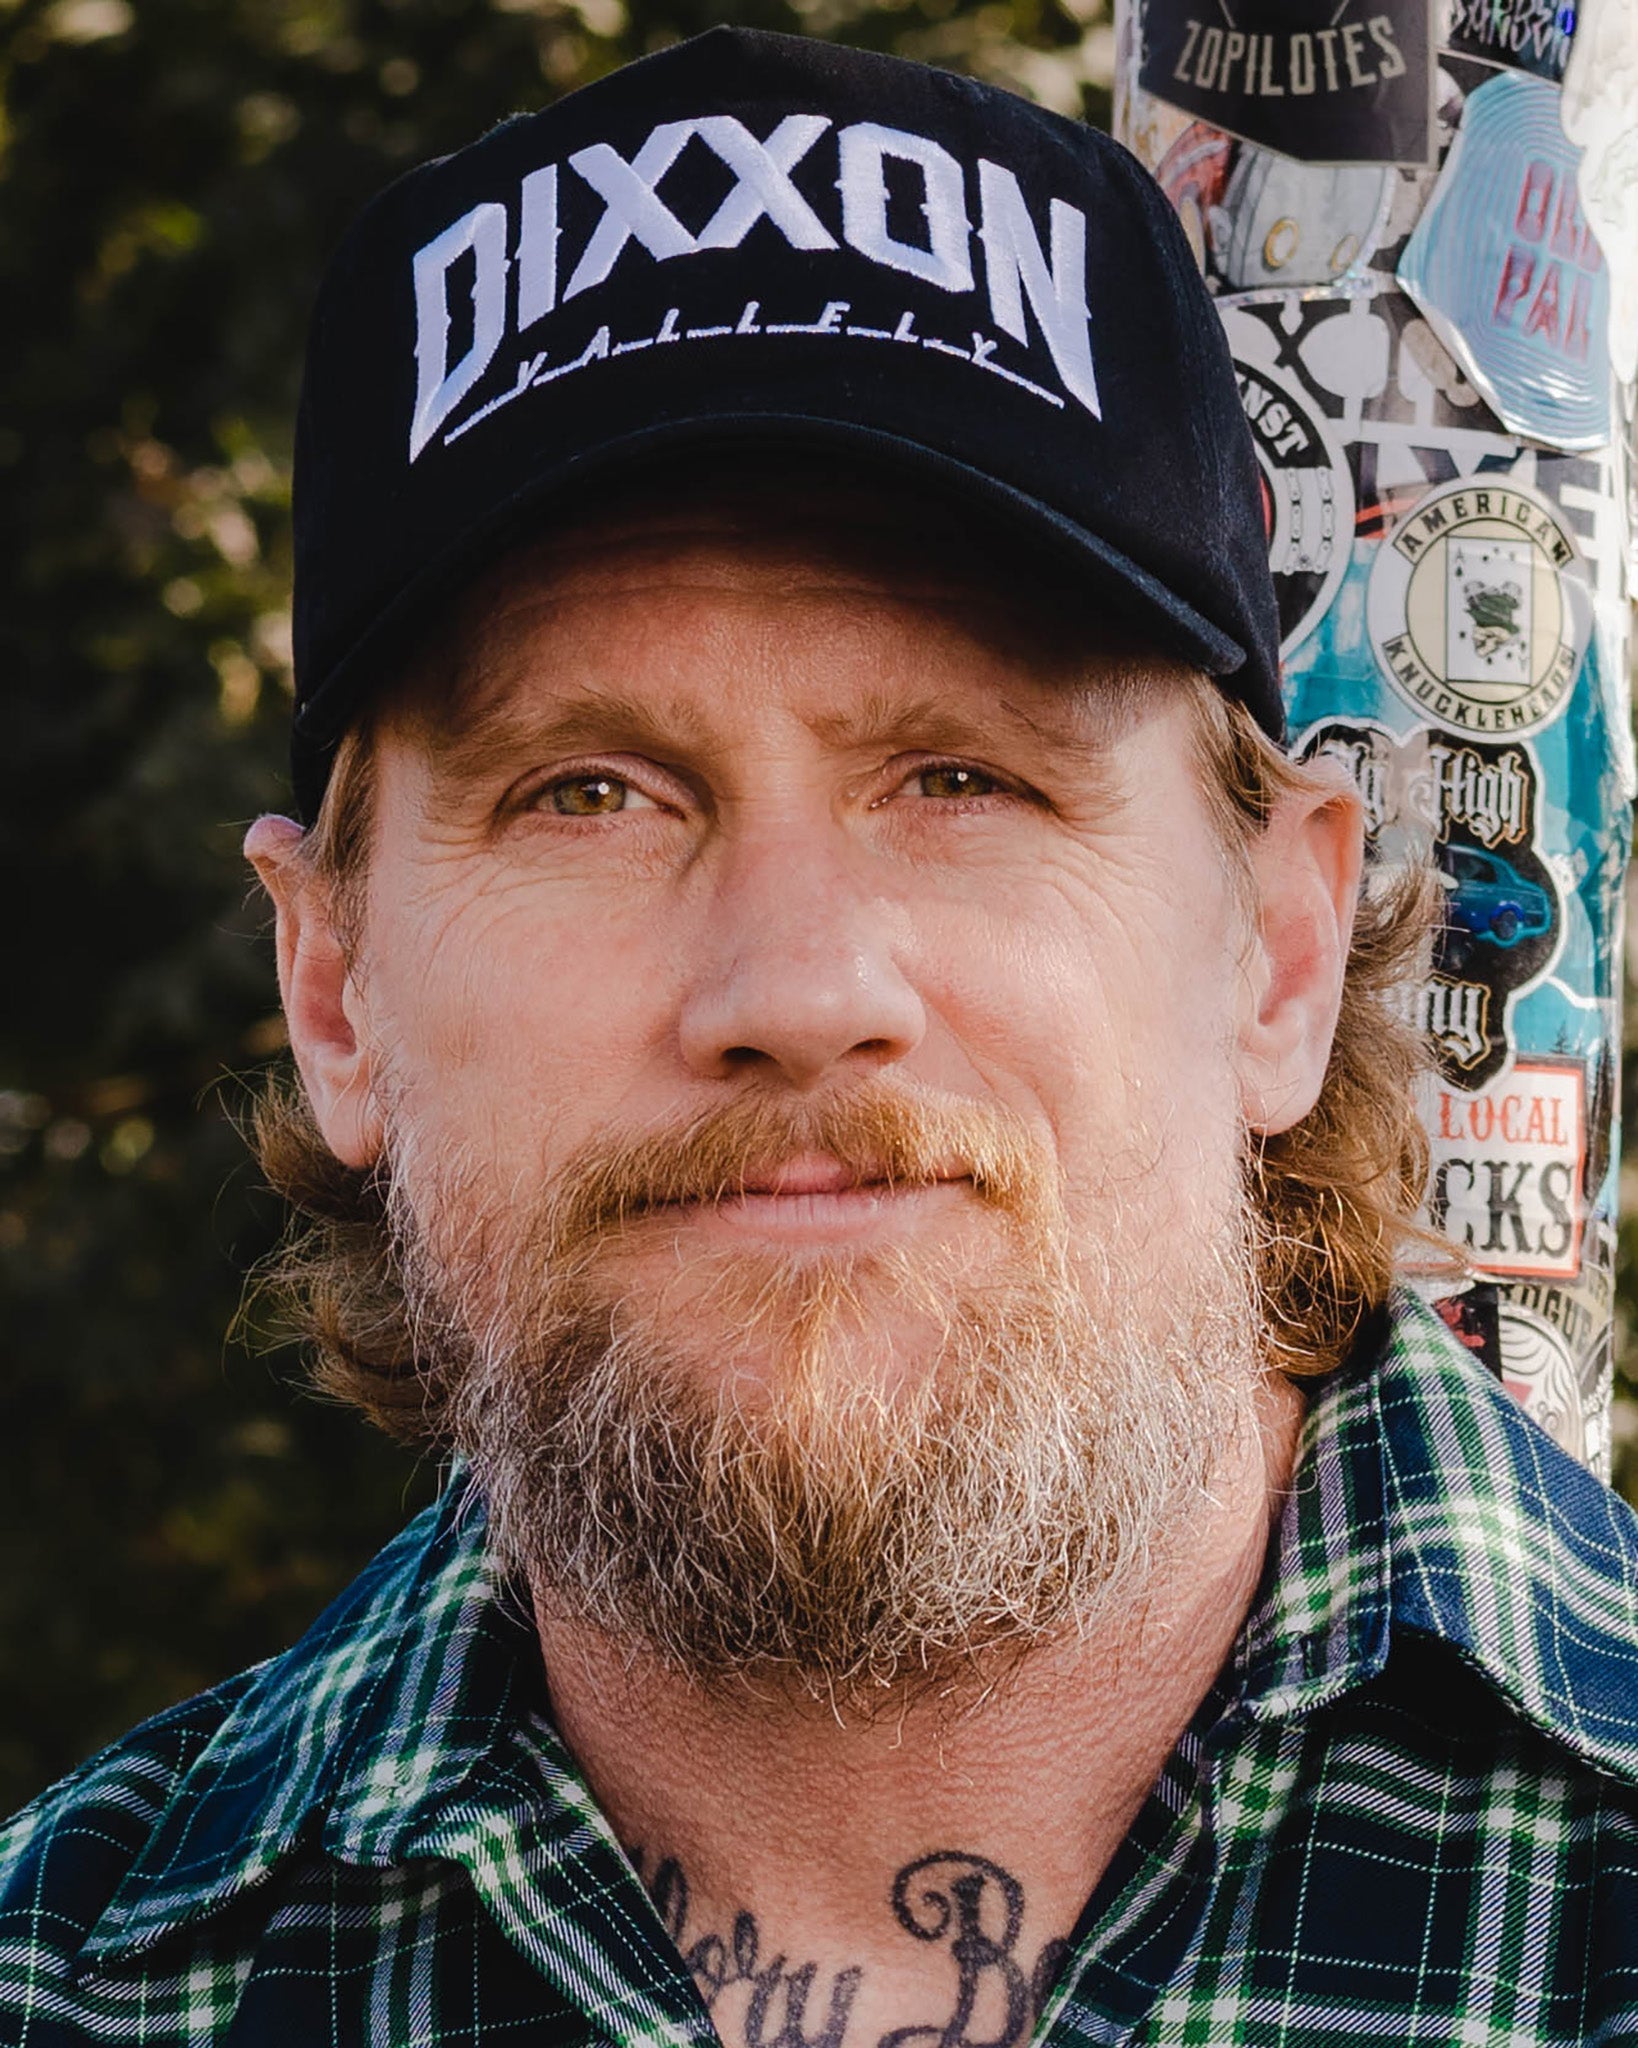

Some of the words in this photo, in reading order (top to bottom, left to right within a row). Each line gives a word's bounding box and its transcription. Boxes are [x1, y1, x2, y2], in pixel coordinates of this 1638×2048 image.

[1173, 15, 1406, 96] ZOPILOTES
[410, 114, 1102, 465] DIXXON
[1494, 244, 1591, 364] PAL
[1401, 493, 1567, 562] AMERICAN
[1385, 642, 1575, 729] KNUCKLEHEADS
[1411, 747, 1526, 846] High
[1439, 1092, 1568, 1145] LOCAL
[1430, 1158, 1573, 1258] CKS
